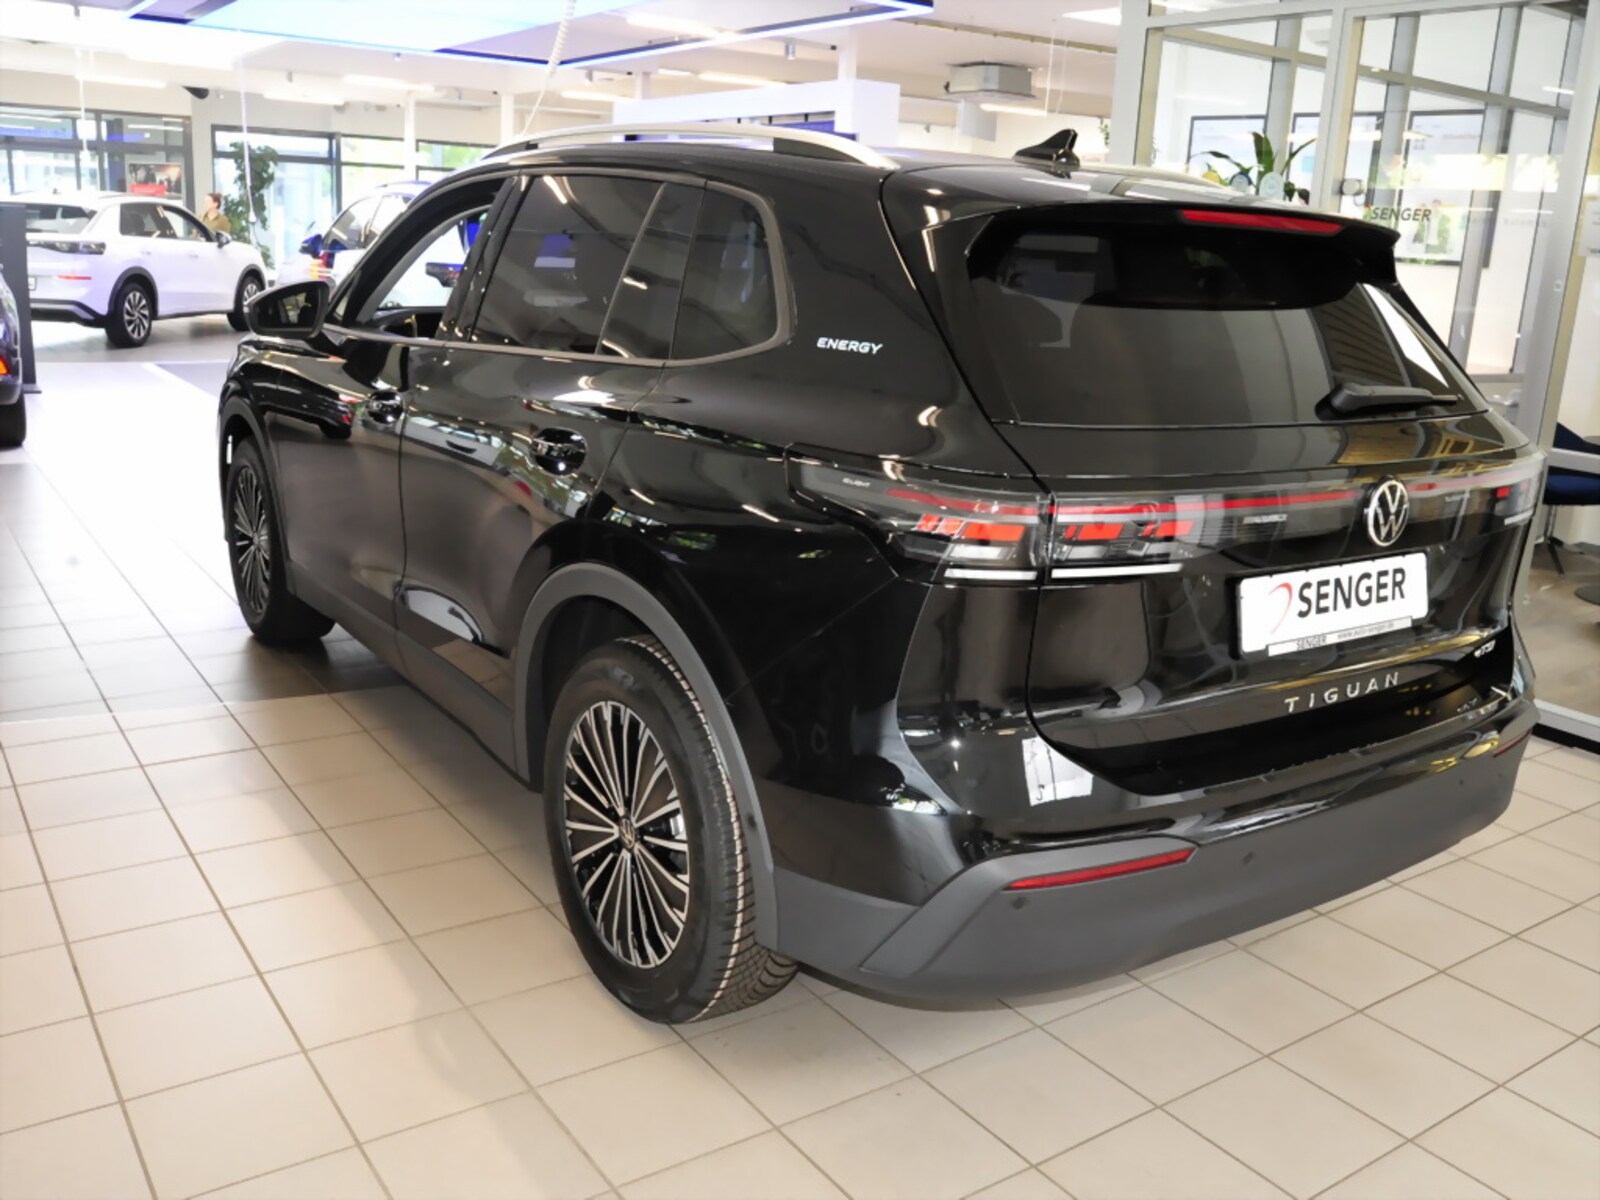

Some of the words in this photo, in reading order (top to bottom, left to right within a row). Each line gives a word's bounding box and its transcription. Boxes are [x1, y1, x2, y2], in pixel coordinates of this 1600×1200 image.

[1370, 207, 1432, 222] SENGER
[816, 336, 883, 355] ENERGY
[1297, 567, 1406, 618] SENGER
[1296, 634, 1327, 650] SENGER
[1284, 671, 1399, 713] TIGUAN
